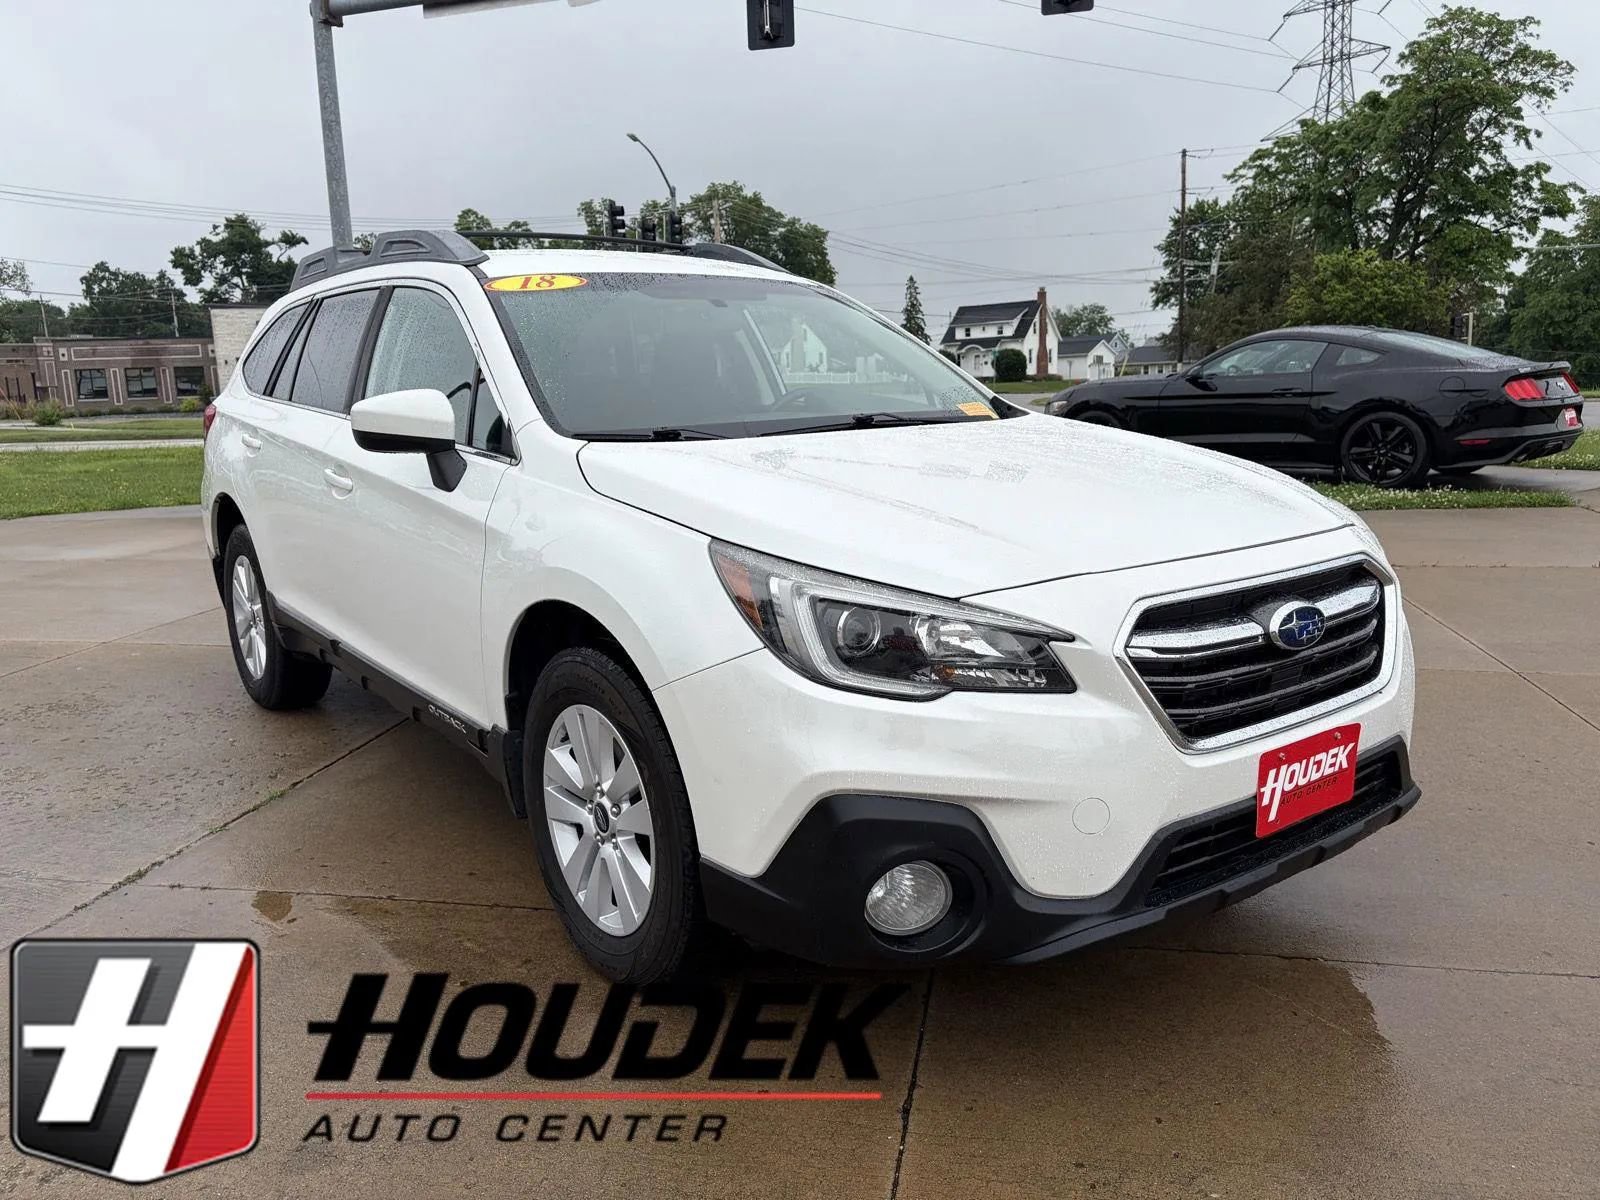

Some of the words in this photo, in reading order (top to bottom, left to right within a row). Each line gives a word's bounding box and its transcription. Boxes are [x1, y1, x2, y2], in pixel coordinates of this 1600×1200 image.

[519, 275, 556, 290] 18
[1260, 742, 1356, 823] HOUDEK
[1280, 790, 1303, 806] AUTO
[1307, 777, 1338, 796] CENTER
